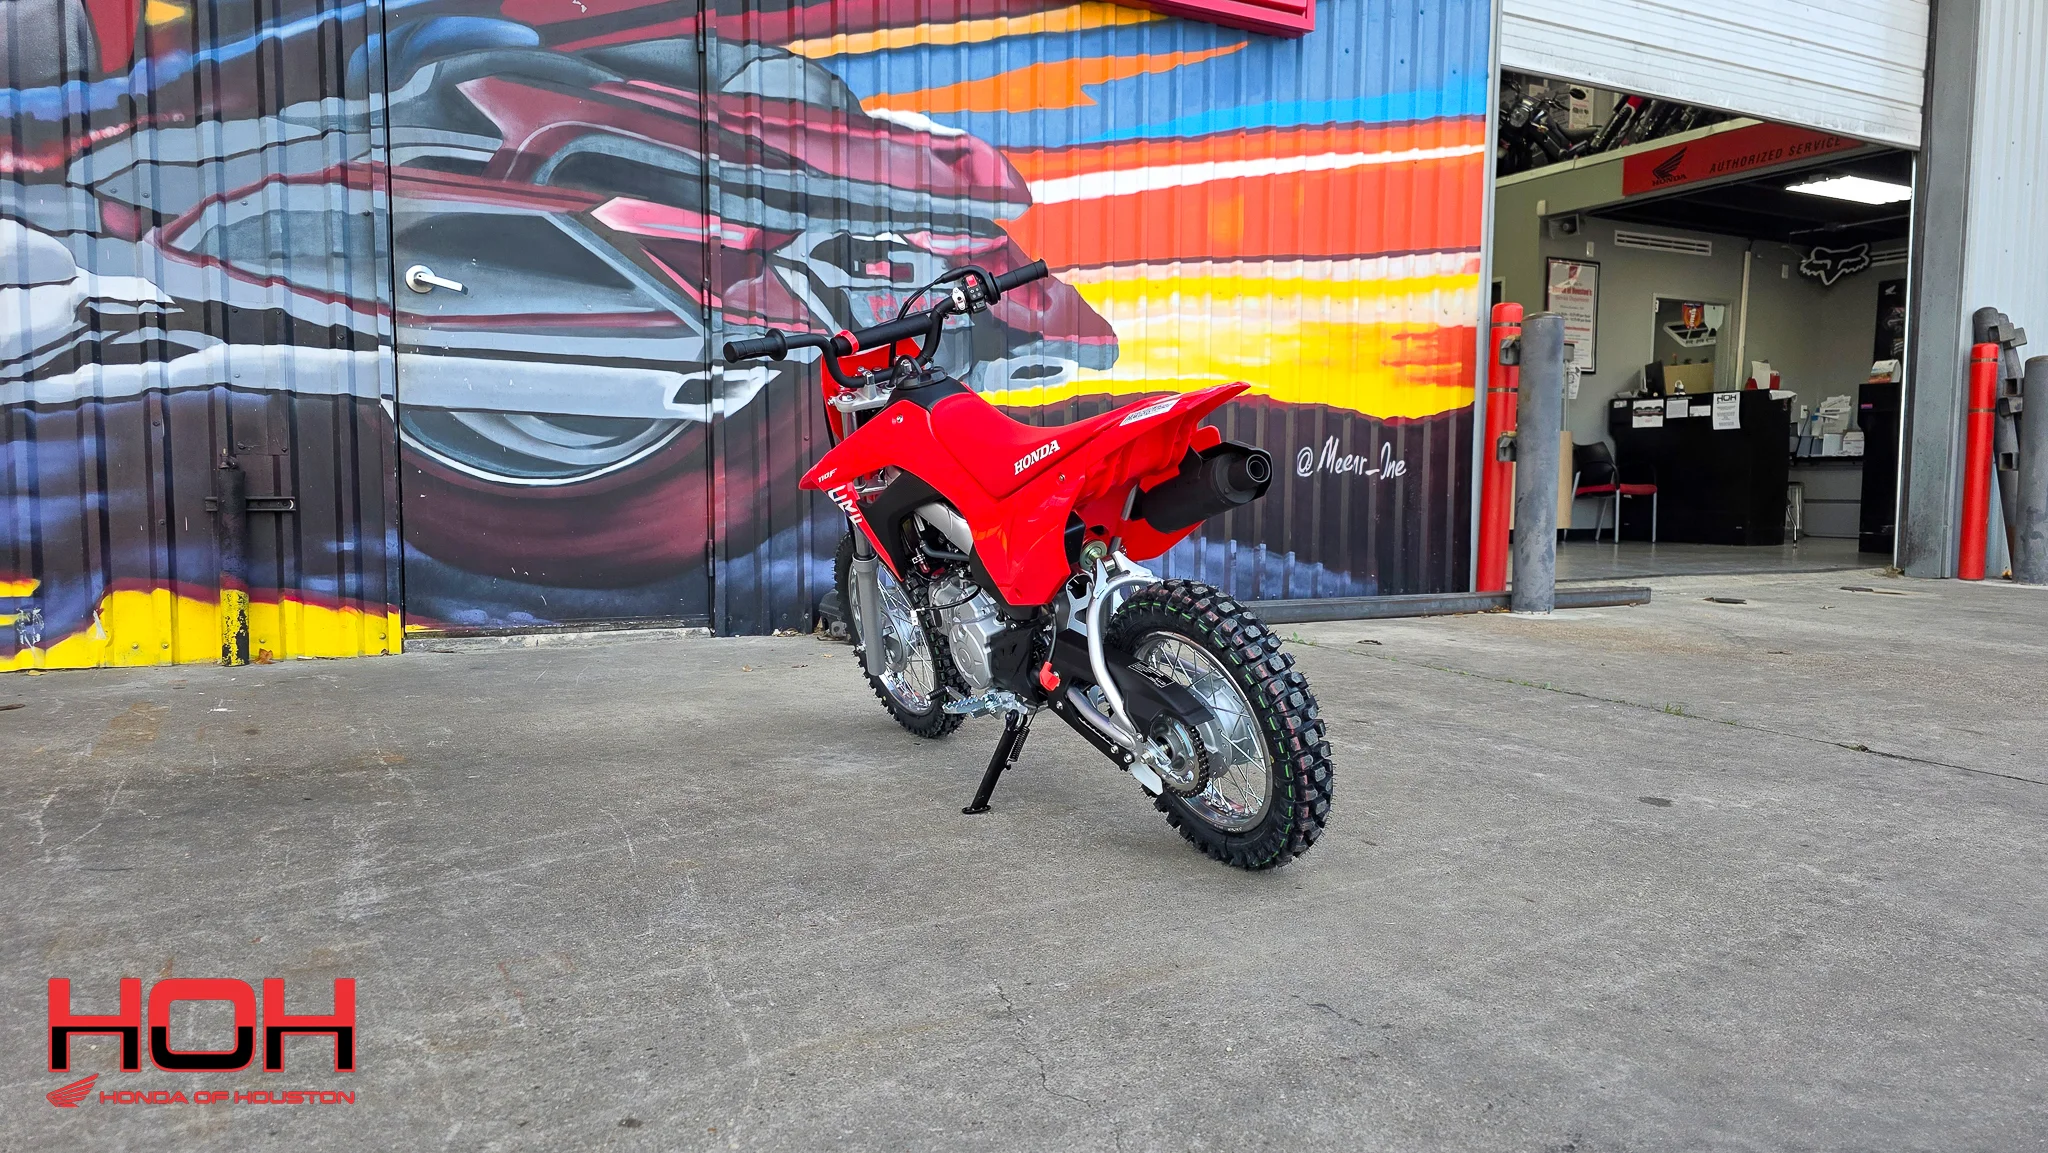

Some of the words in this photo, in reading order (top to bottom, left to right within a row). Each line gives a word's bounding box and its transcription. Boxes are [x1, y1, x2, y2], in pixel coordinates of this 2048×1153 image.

[1709, 149, 1782, 174] AUTHORIZED
[1788, 137, 1841, 156] SERVICE
[1651, 174, 1688, 187] HONDA
[1716, 394, 1737, 402] HOH
[1014, 440, 1061, 476] HONDA
[827, 485, 863, 528] CRF
